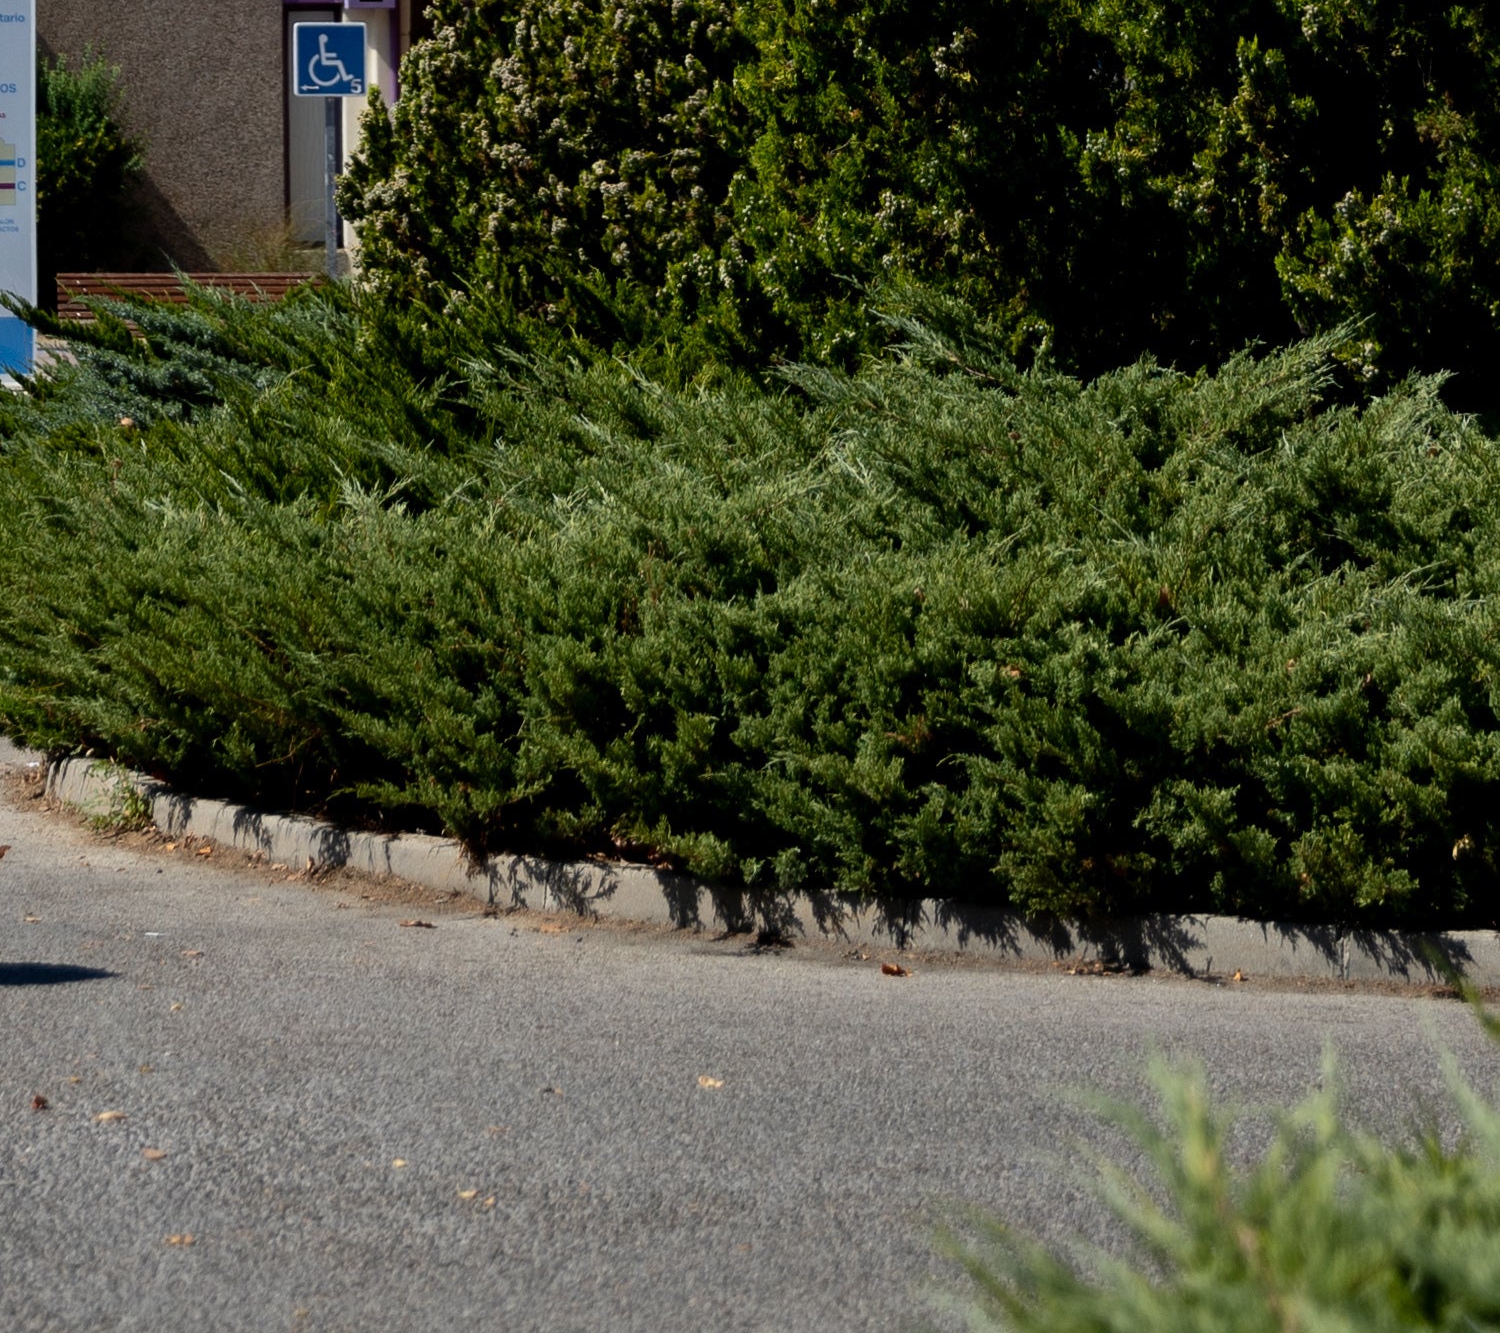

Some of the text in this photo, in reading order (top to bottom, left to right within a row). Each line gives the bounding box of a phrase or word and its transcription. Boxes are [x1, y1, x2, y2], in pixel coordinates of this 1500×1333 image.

[350, 78, 362, 94] 5
[17, 158, 26, 168] D
[17, 181, 27, 191] C
